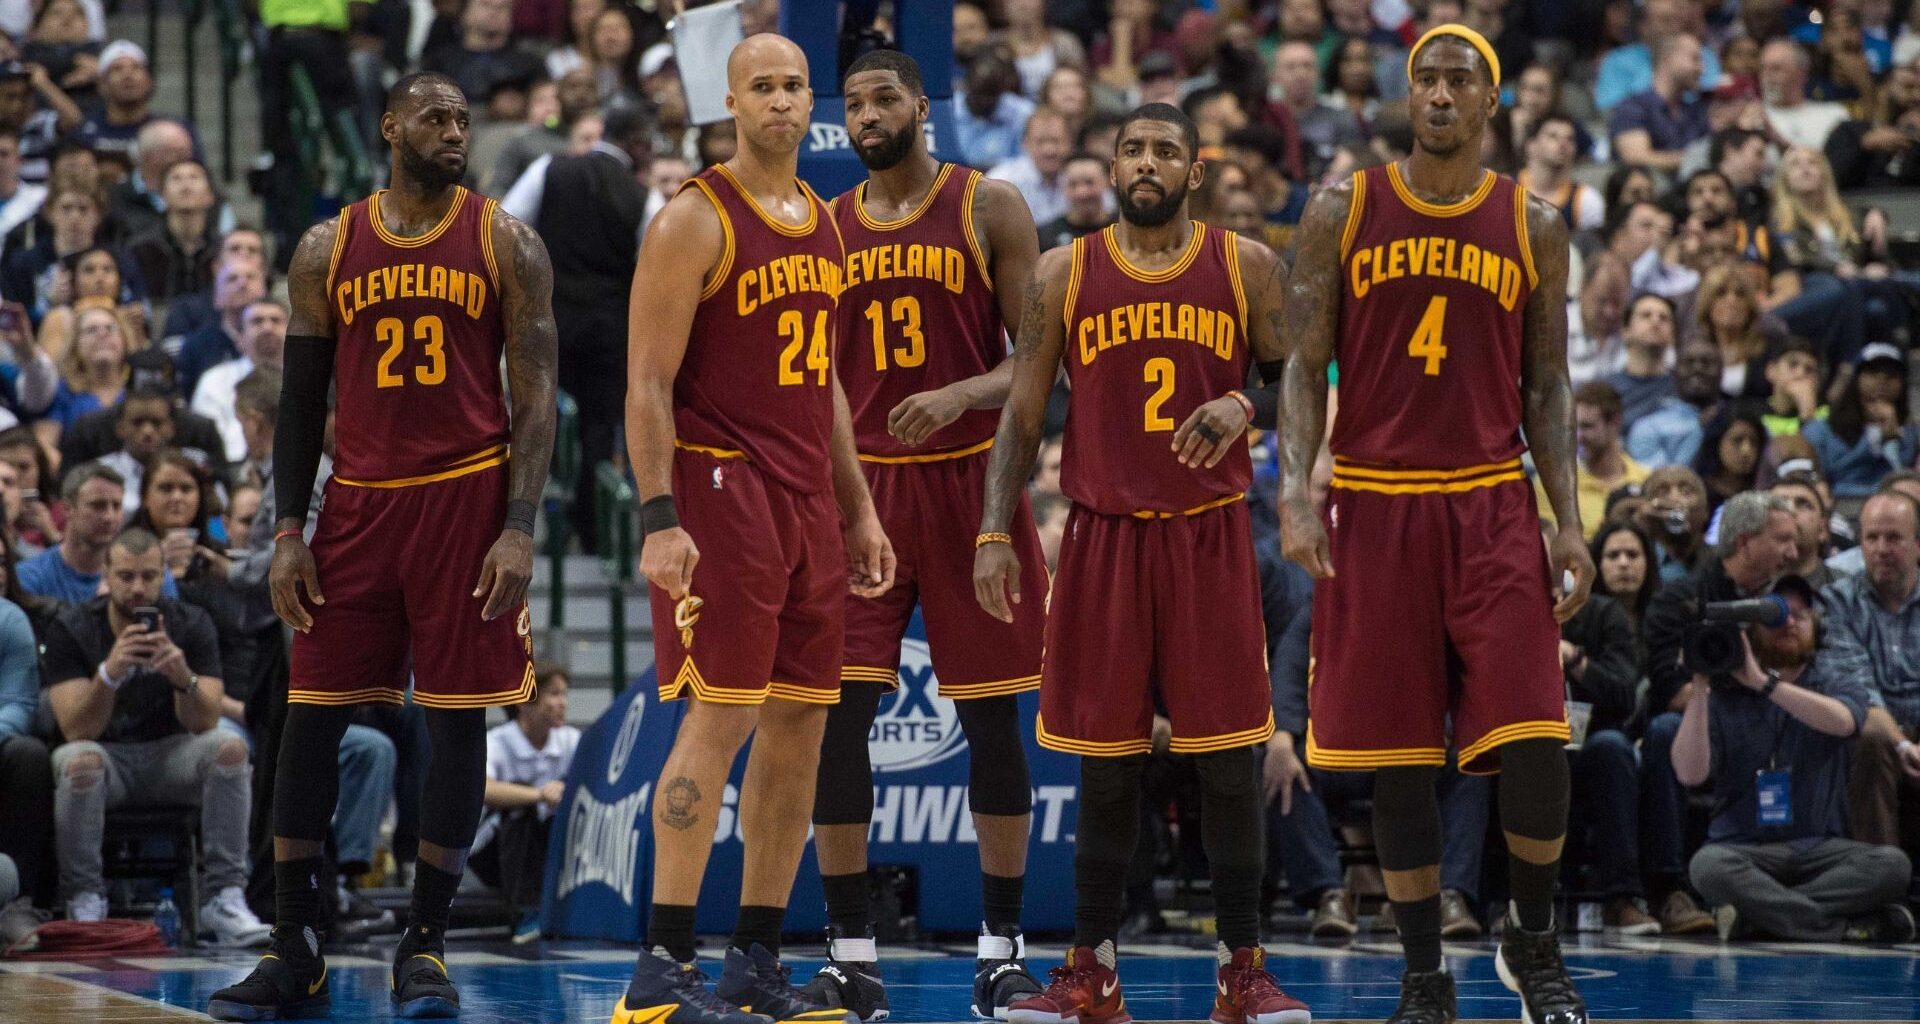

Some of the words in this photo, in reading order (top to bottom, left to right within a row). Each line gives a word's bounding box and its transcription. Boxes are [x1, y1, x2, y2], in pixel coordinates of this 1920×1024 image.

[337, 263, 486, 326] CLEVELAND
[737, 254, 839, 316] CLEVELAN
[837, 244, 965, 296] LEVELAND
[1351, 236, 1522, 312] CLEVELAND
[375, 315, 447, 389] 23
[778, 309, 830, 387] 24
[864, 295, 926, 371] 13
[1078, 302, 1235, 366] CLEVELAND
[1408, 295, 1448, 376] 4
[1143, 357, 1176, 433] 2
